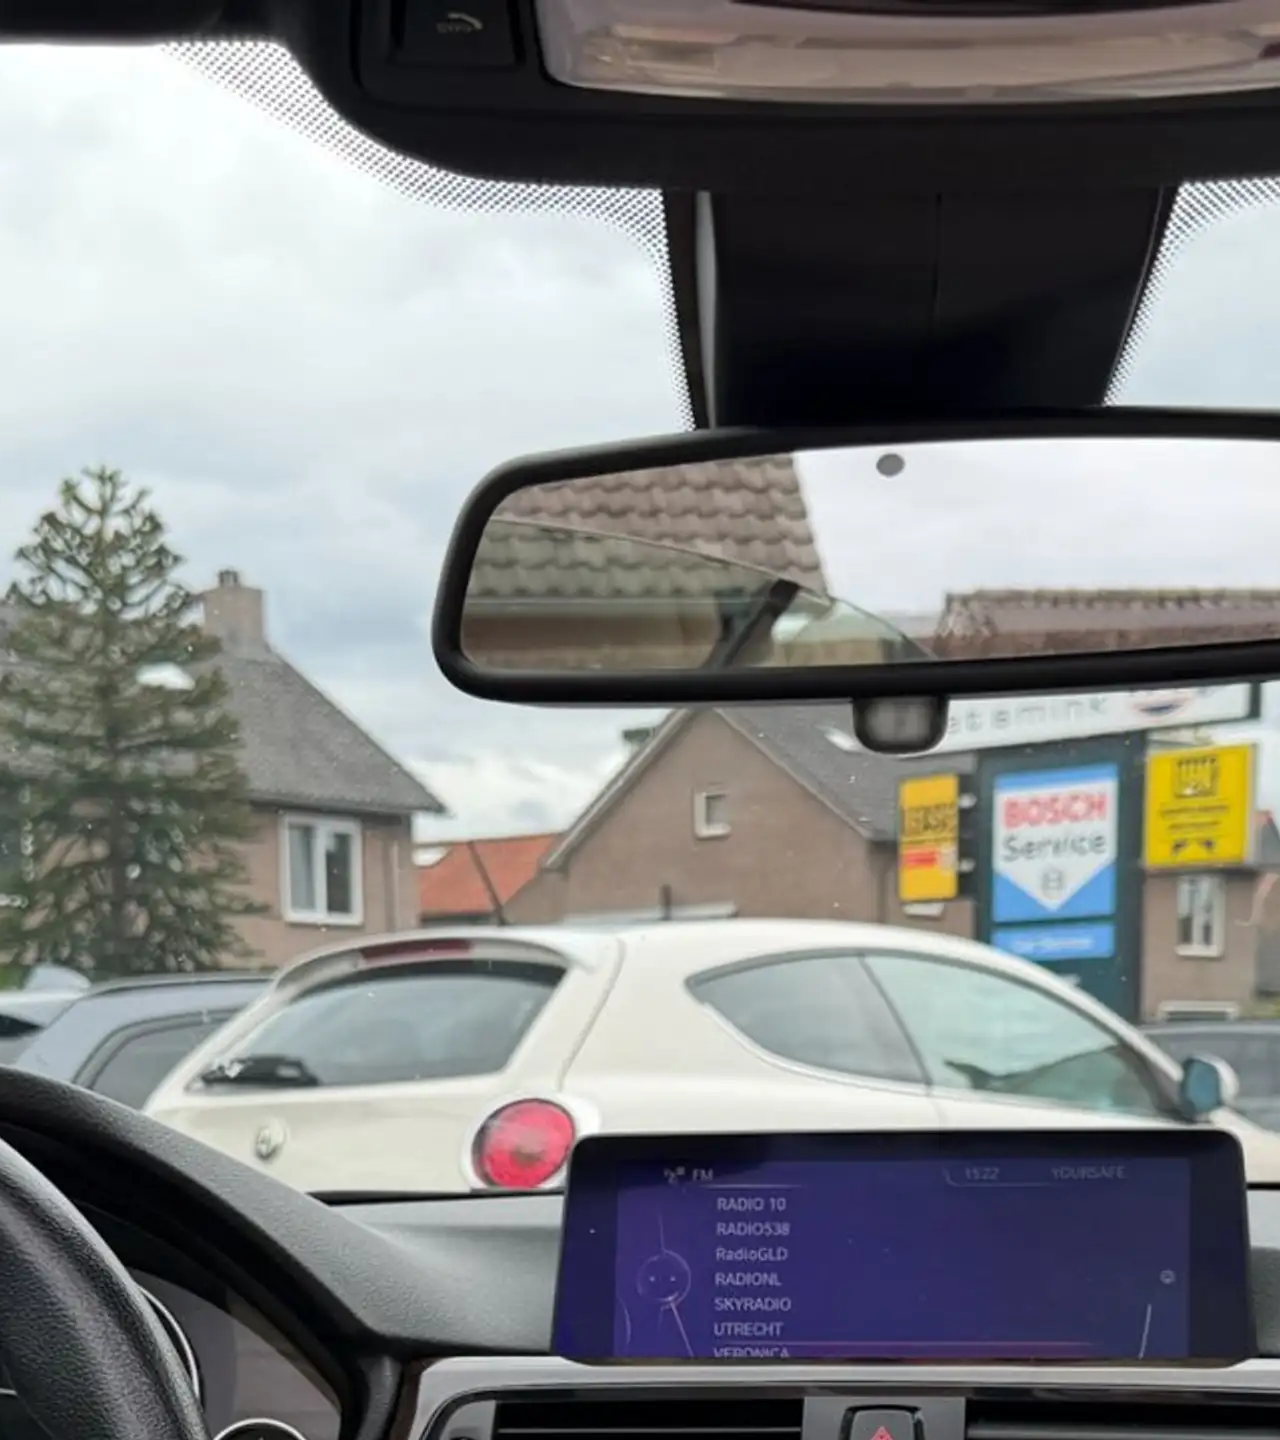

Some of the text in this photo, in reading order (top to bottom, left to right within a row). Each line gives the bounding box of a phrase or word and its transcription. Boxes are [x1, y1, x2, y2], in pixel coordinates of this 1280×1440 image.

[1004, 793, 1107, 828] BOSCH
[1002, 833, 1107, 862] Service
[692, 1169, 714, 1181] FM
[717, 1197, 787, 1211] RADIO 10
[716, 1222, 790, 1236] RADIO538
[716, 1247, 788, 1261] RadioGLD
[714, 1273, 782, 1286] RADIONL
[714, 1298, 791, 1311] SKYRADIO
[713, 1323, 784, 1336] UTRECHT
